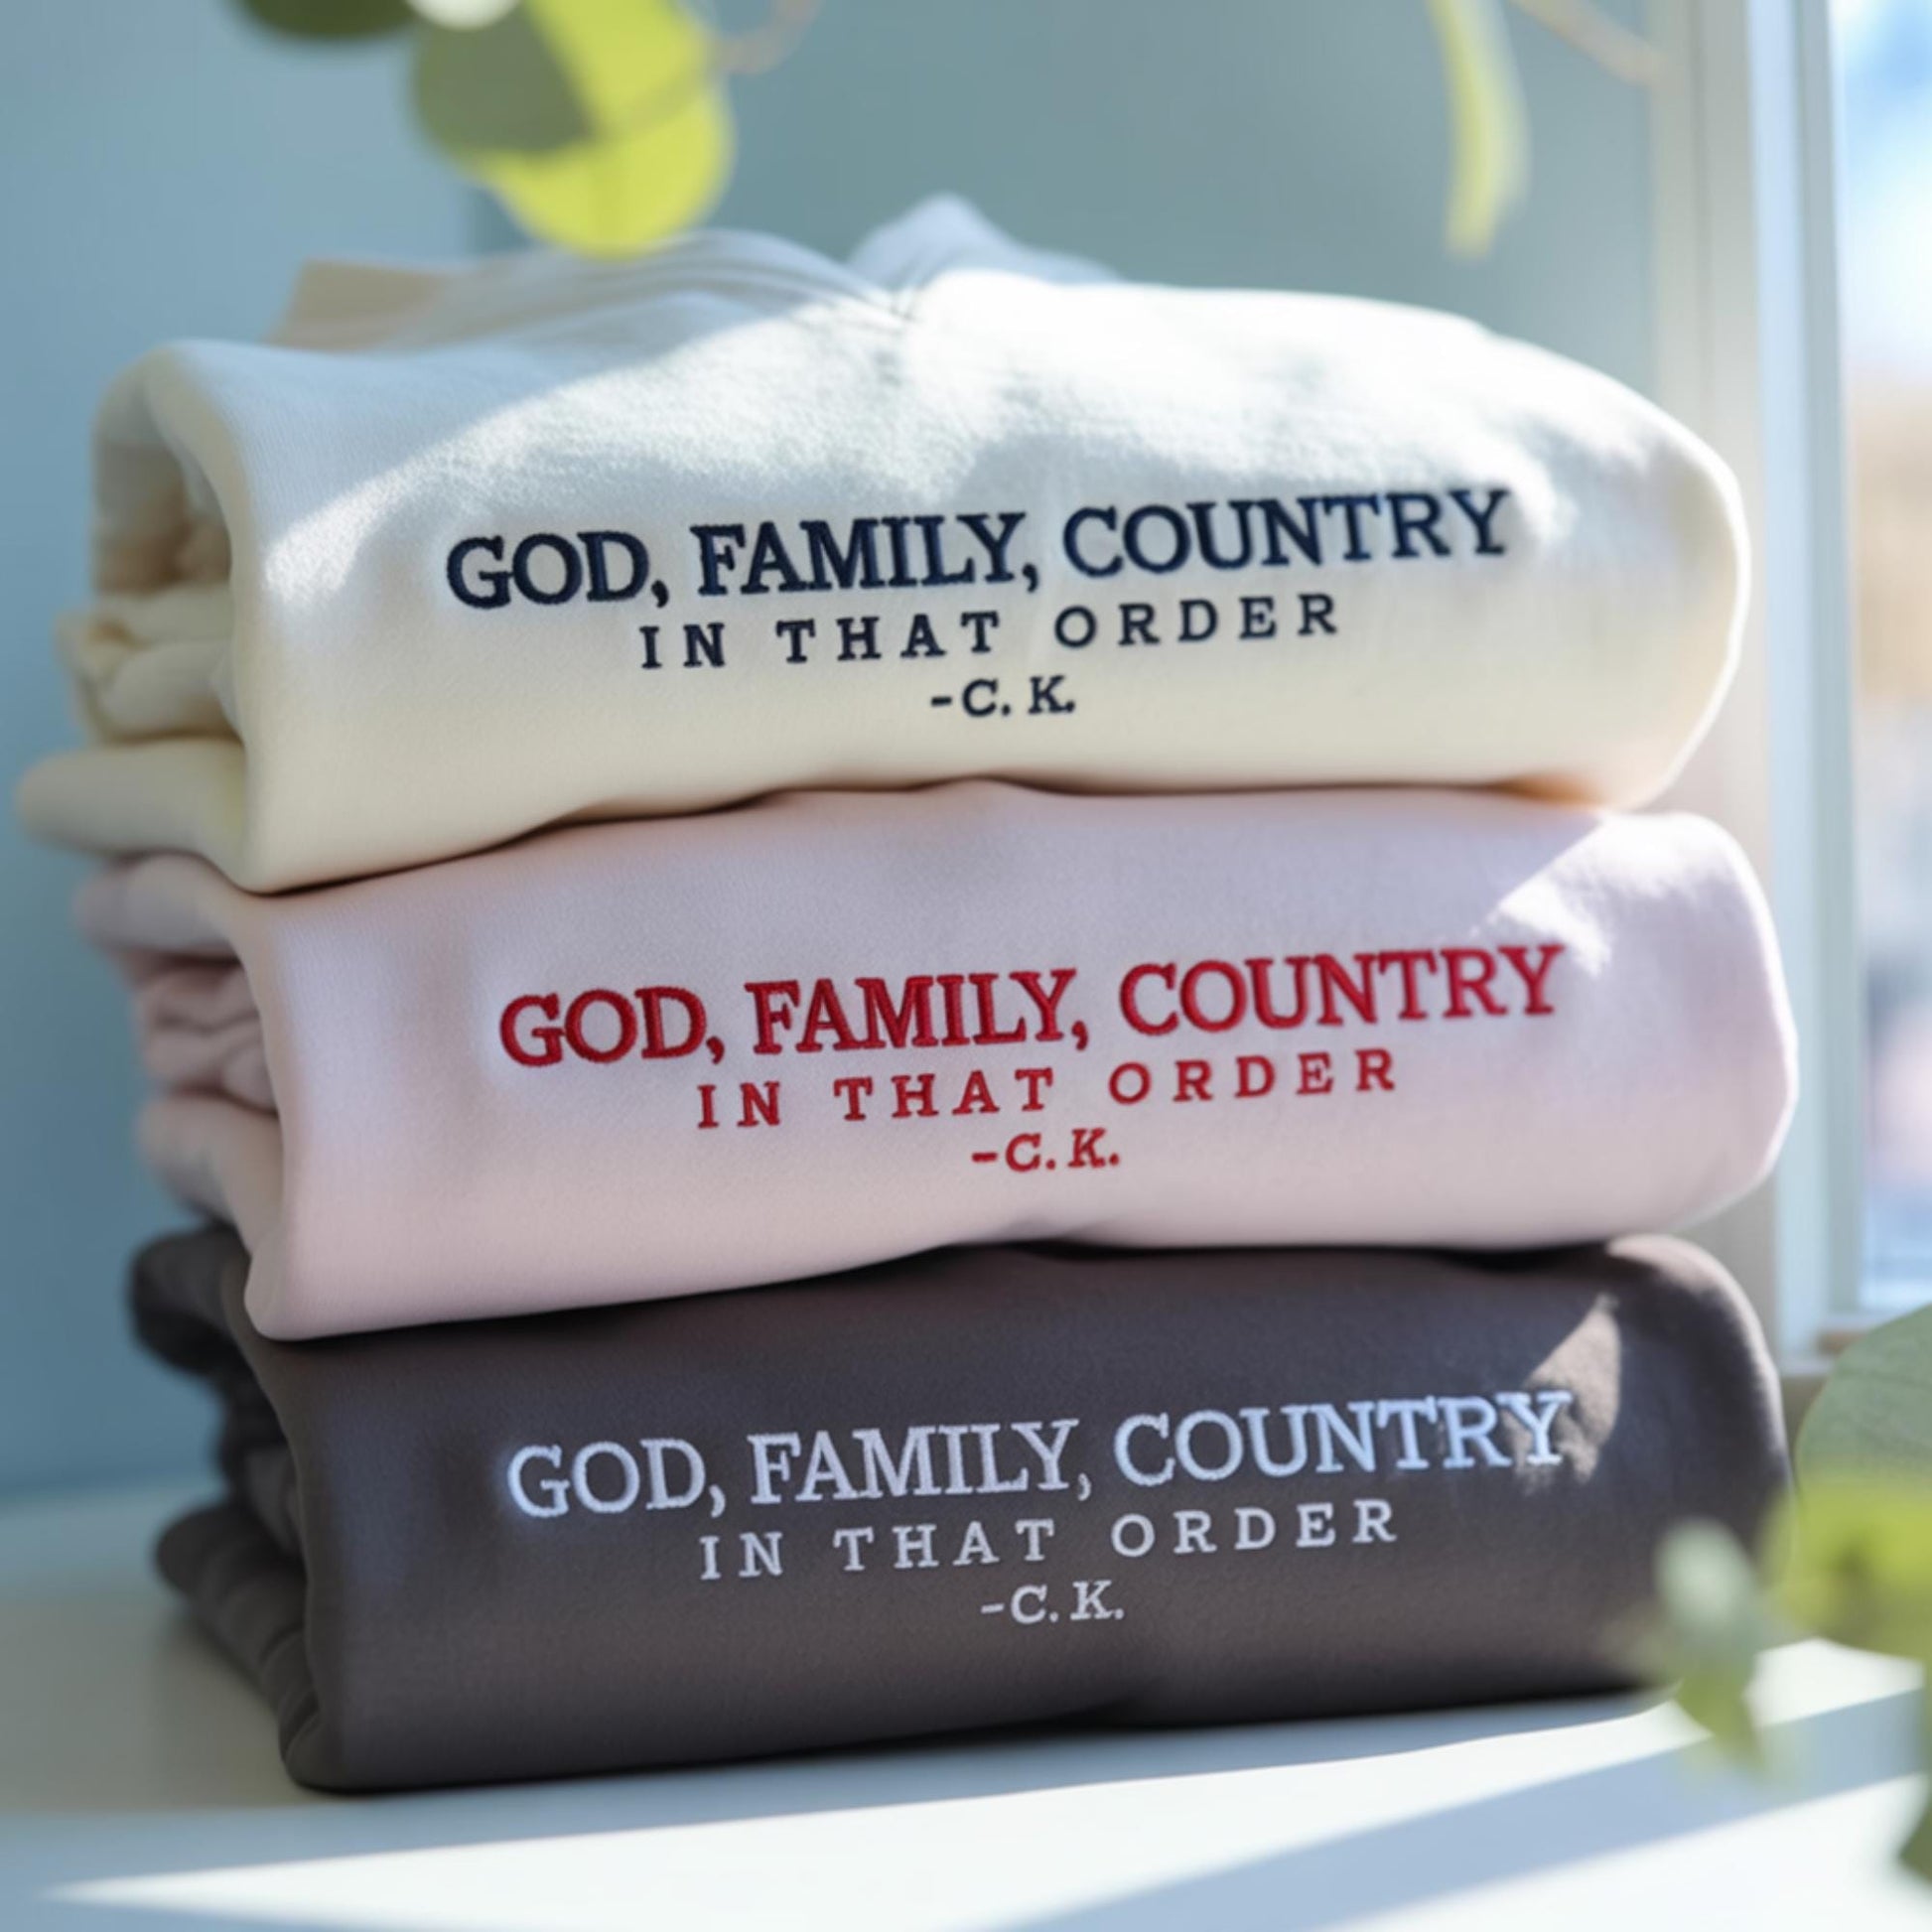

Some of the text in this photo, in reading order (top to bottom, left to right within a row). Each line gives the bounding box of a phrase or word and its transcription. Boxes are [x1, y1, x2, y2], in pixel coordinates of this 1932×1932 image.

[446, 489, 1507, 611] GOD, FAMILY, COUNTRY
[638, 593, 1337, 670] IN THAT ORDER
[499, 943, 1563, 1065] GOD, FAMILY, COUNTRY
[699, 1047, 1395, 1129] IN THAT ORDER
[506, 1392, 1572, 1518] GOD, FAMILY, COUNTRY
[699, 1498, 1397, 1581] IN THAT ORDER
